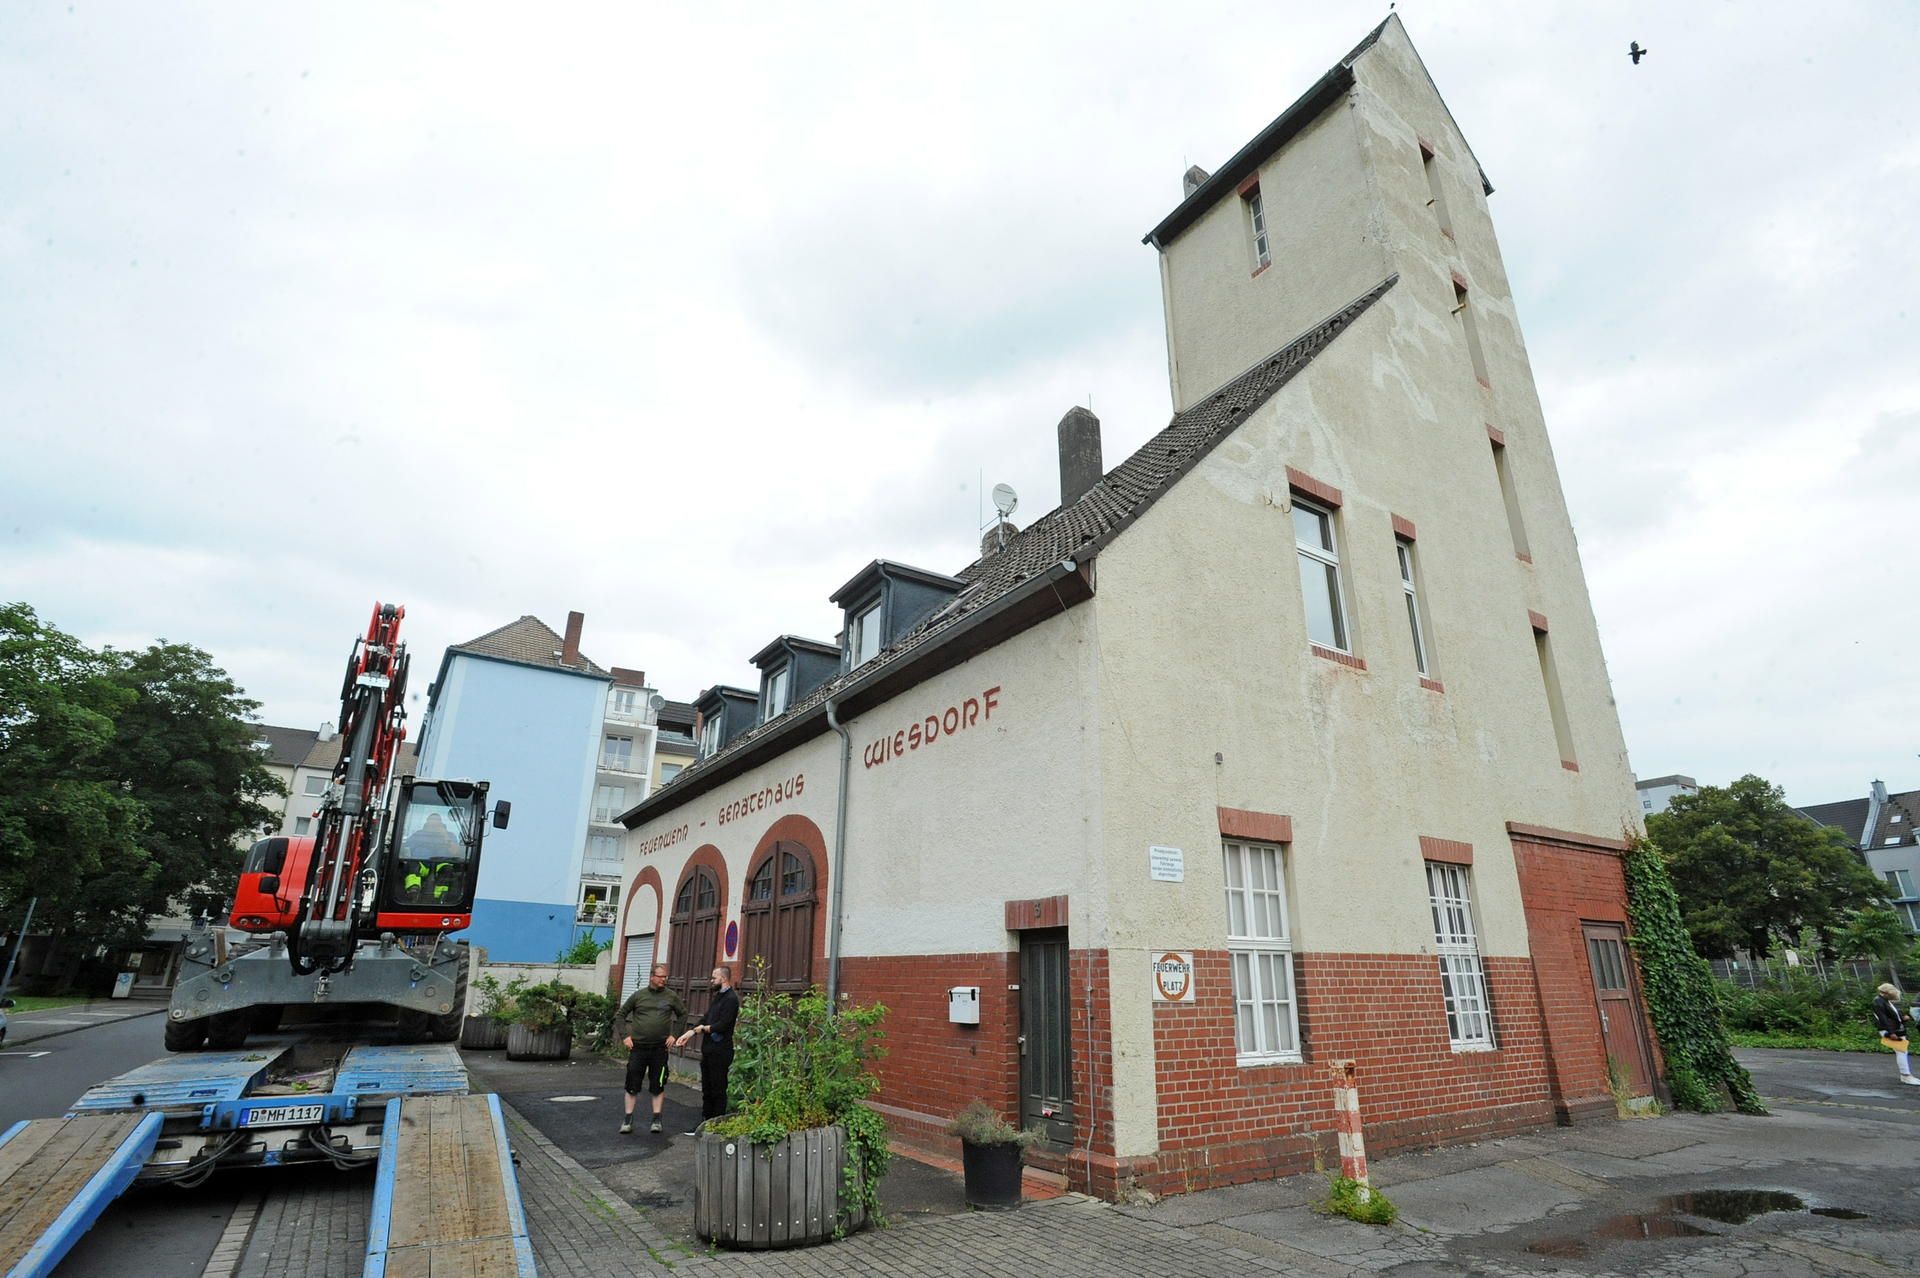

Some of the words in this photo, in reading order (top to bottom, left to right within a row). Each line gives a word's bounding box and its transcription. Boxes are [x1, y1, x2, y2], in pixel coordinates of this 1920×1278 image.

[639, 823, 689, 857] FEUERWEHR
[864, 685, 1001, 769] WIESDORF
[1153, 962, 1191, 973] FEUERWEHR
[1163, 981, 1183, 991] PLATZ
[249, 1110, 259, 1122] D
[267, 1109, 286, 1121] MH
[288, 1107, 322, 1120] 1117
